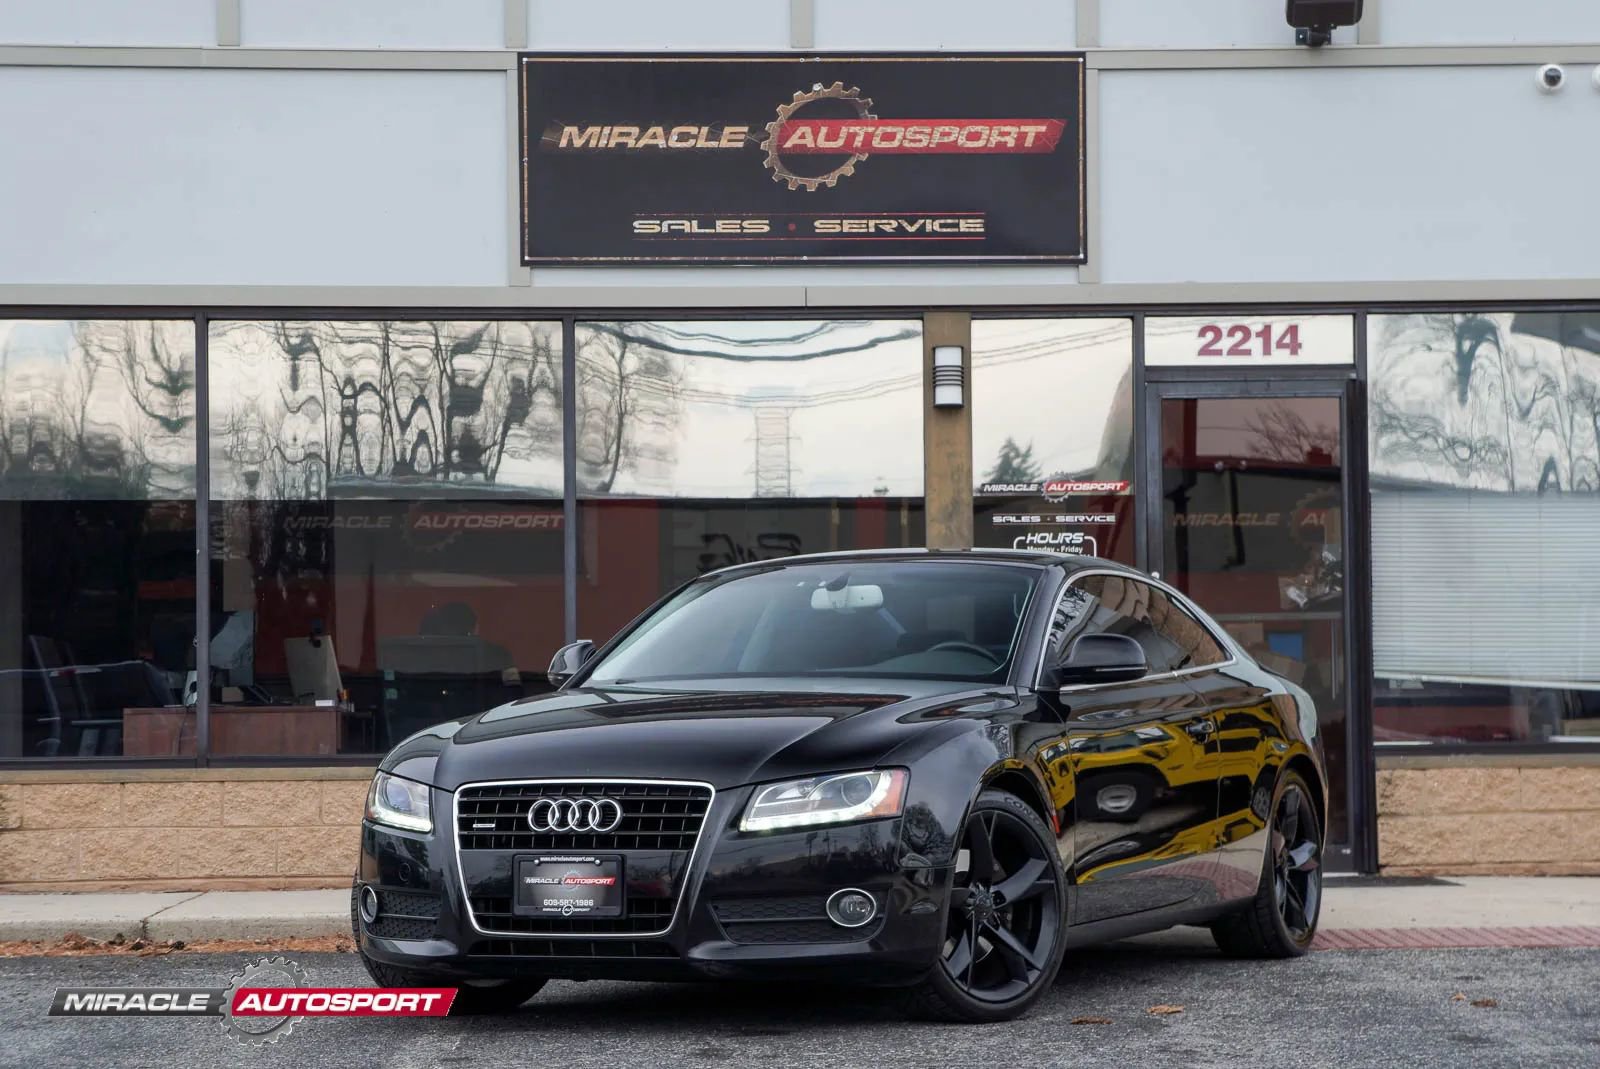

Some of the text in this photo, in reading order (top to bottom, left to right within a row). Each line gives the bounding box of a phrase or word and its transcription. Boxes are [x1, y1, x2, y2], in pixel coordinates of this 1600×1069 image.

[558, 123, 1047, 149] MIRACLE AUTOSPORT
[632, 218, 986, 234] SALES SERVICE
[1197, 324, 1302, 356] 2214
[983, 482, 1124, 492] MIRACLE AUTOSPORT
[283, 514, 564, 529] MIRACLE AUTOSPORT
[992, 515, 1041, 523] SALES
[1173, 512, 1281, 527] MIRACLE
[1026, 532, 1084, 544] HOURS
[1060, 545, 1084, 554] Friday
[525, 877, 613, 885] MIRACLE AUTOSPORT
